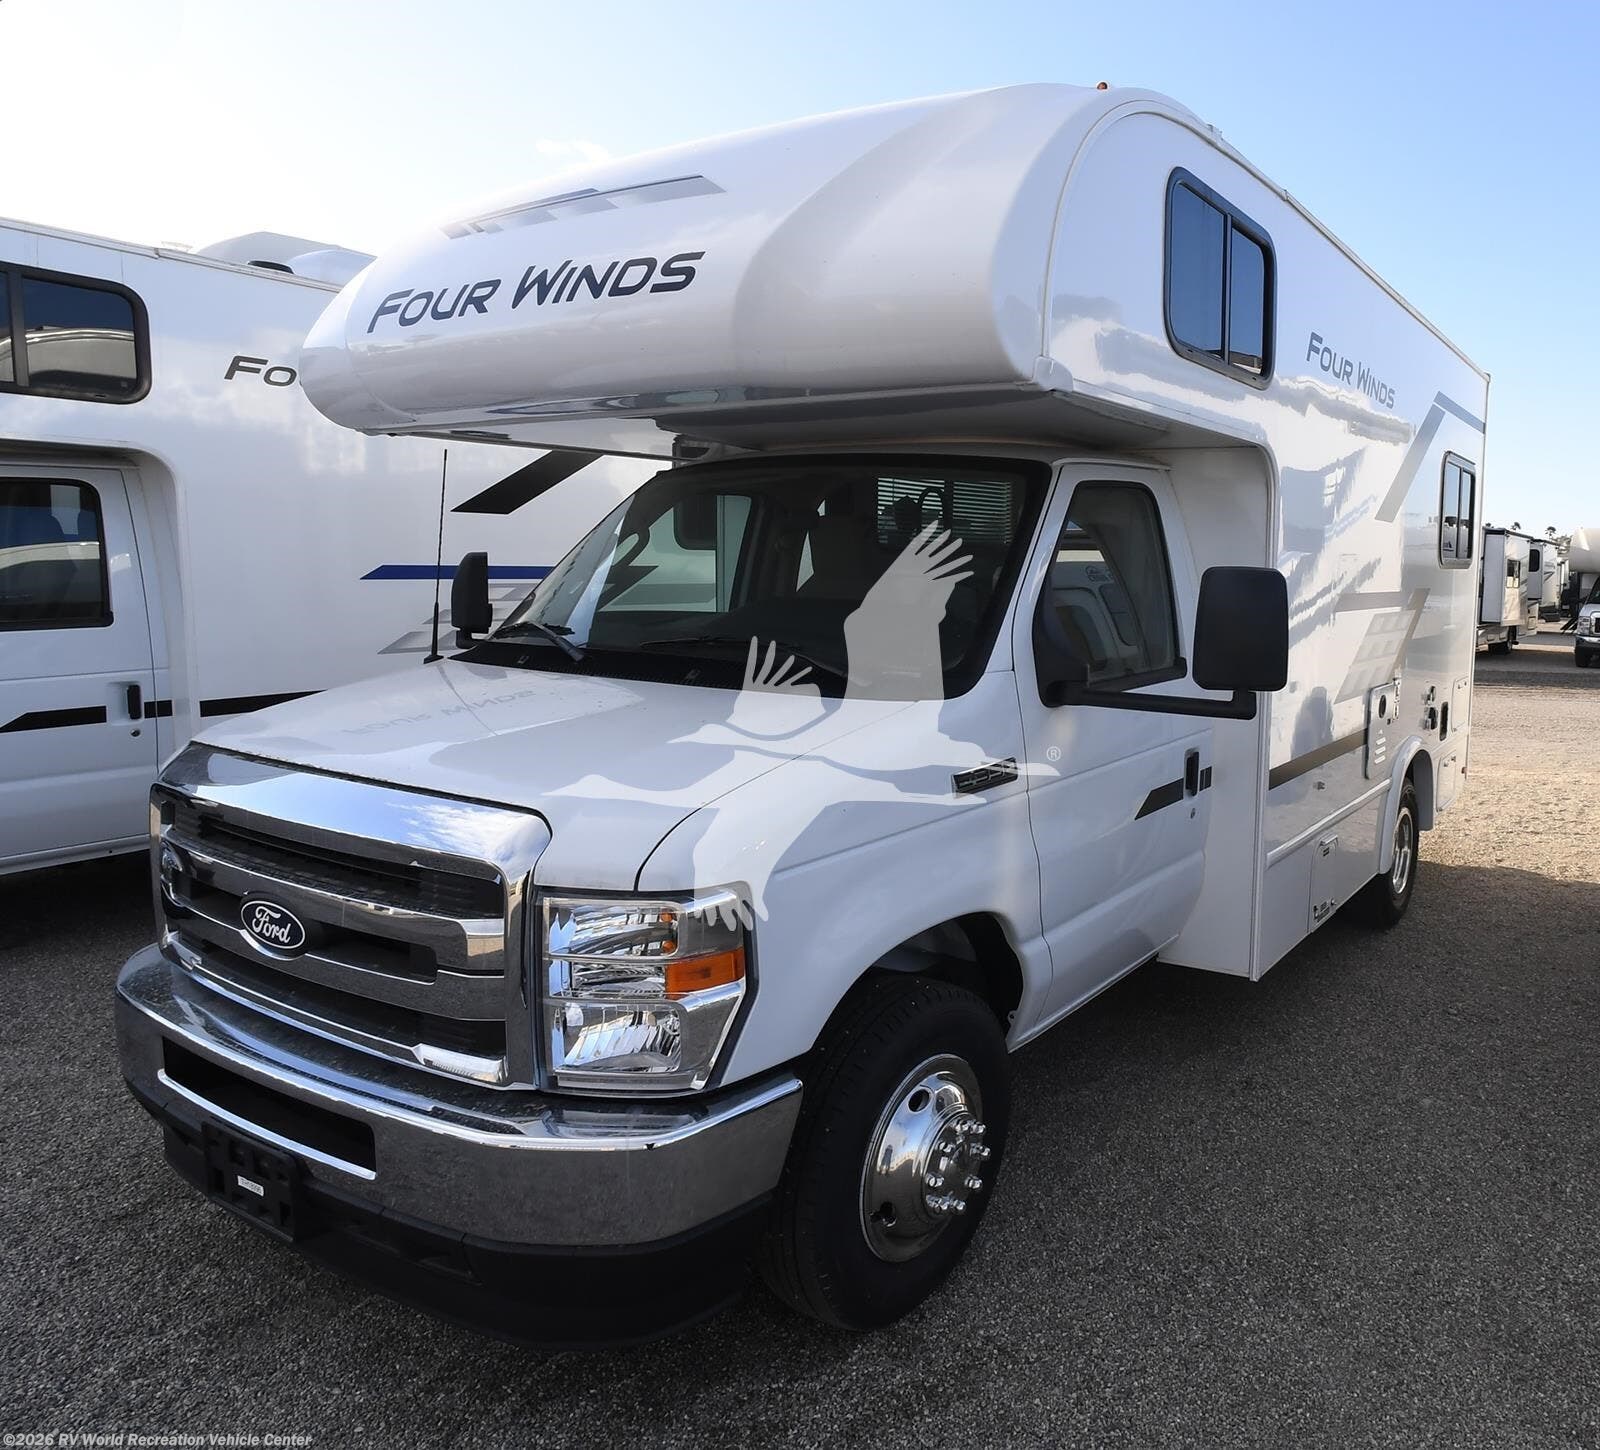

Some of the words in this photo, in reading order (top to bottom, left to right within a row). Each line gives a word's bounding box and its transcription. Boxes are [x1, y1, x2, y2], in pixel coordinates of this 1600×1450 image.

[367, 278, 502, 334] FOUR
[511, 250, 706, 309] WINDS
[223, 355, 302, 388] FO
[1306, 331, 1354, 386] FOUR
[1357, 361, 1396, 410] WINDS
[252, 905, 292, 944] Ford
